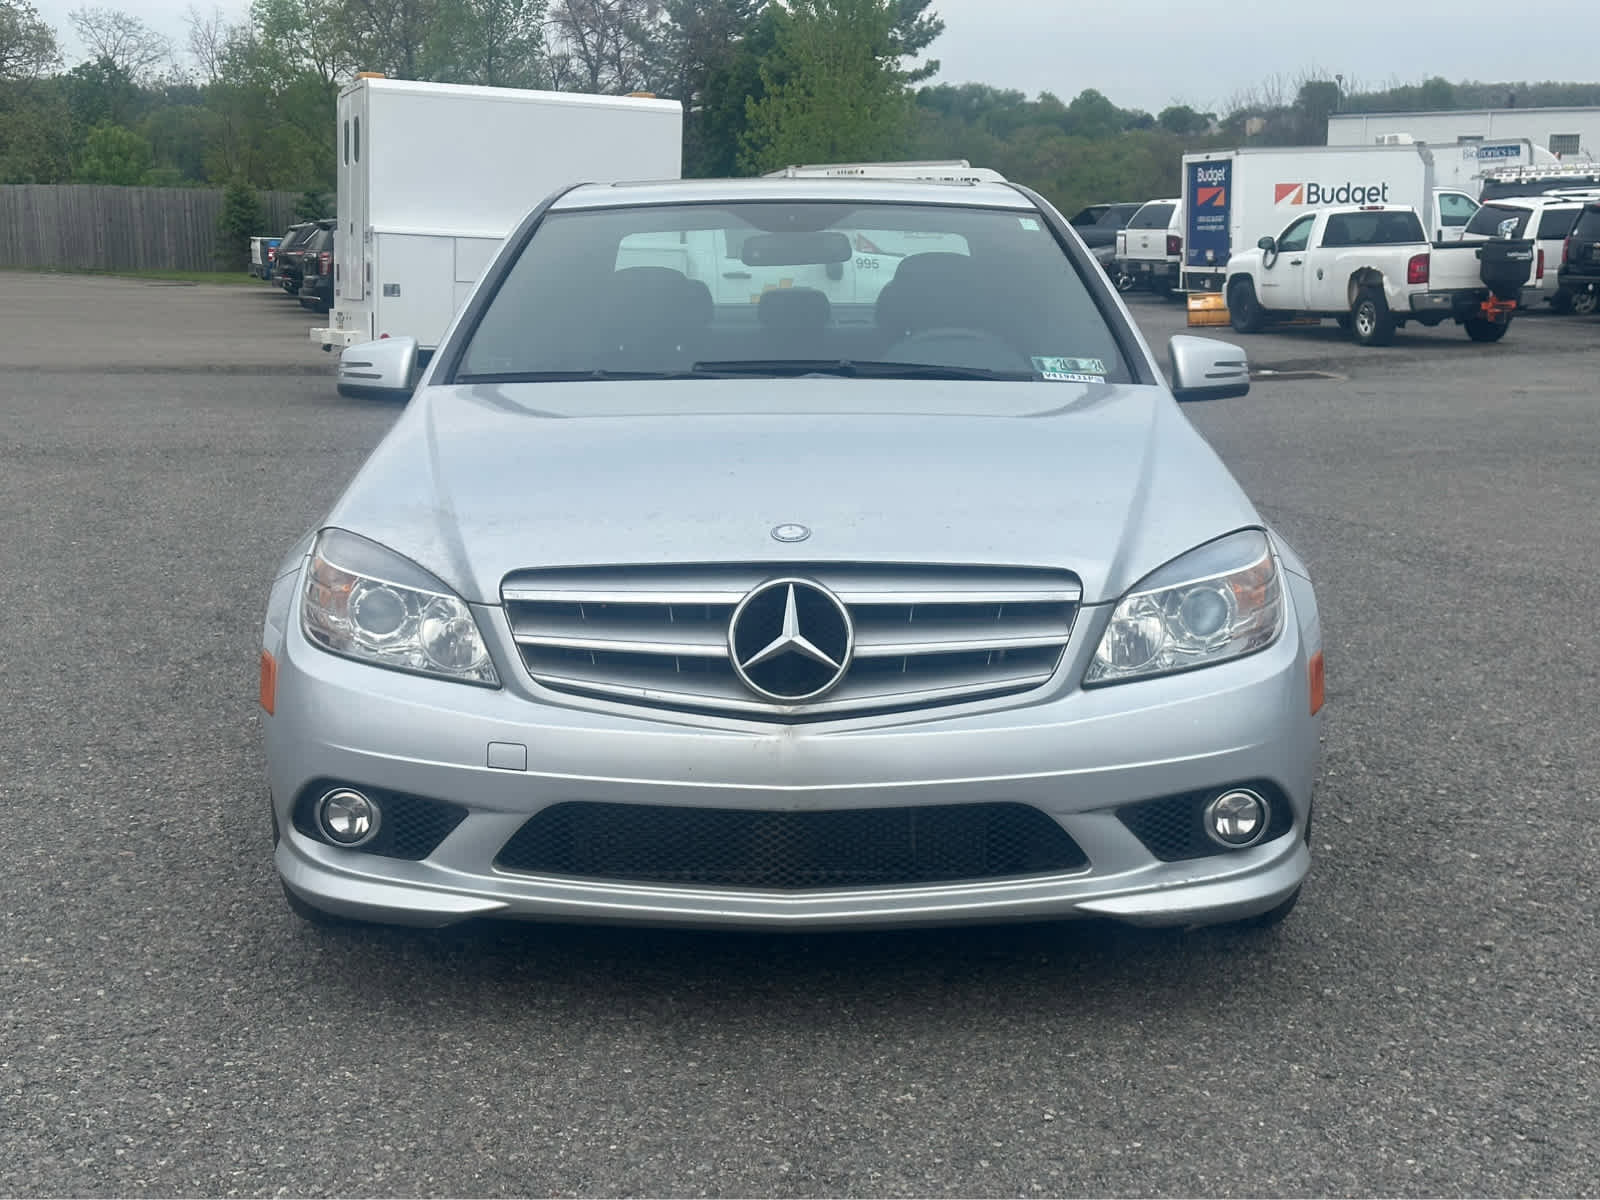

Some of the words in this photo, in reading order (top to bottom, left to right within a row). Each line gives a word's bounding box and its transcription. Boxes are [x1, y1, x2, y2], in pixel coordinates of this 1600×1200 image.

[1197, 167, 1225, 186] Budget
[1307, 182, 1388, 205] Budget
[856, 257, 880, 269] 995
